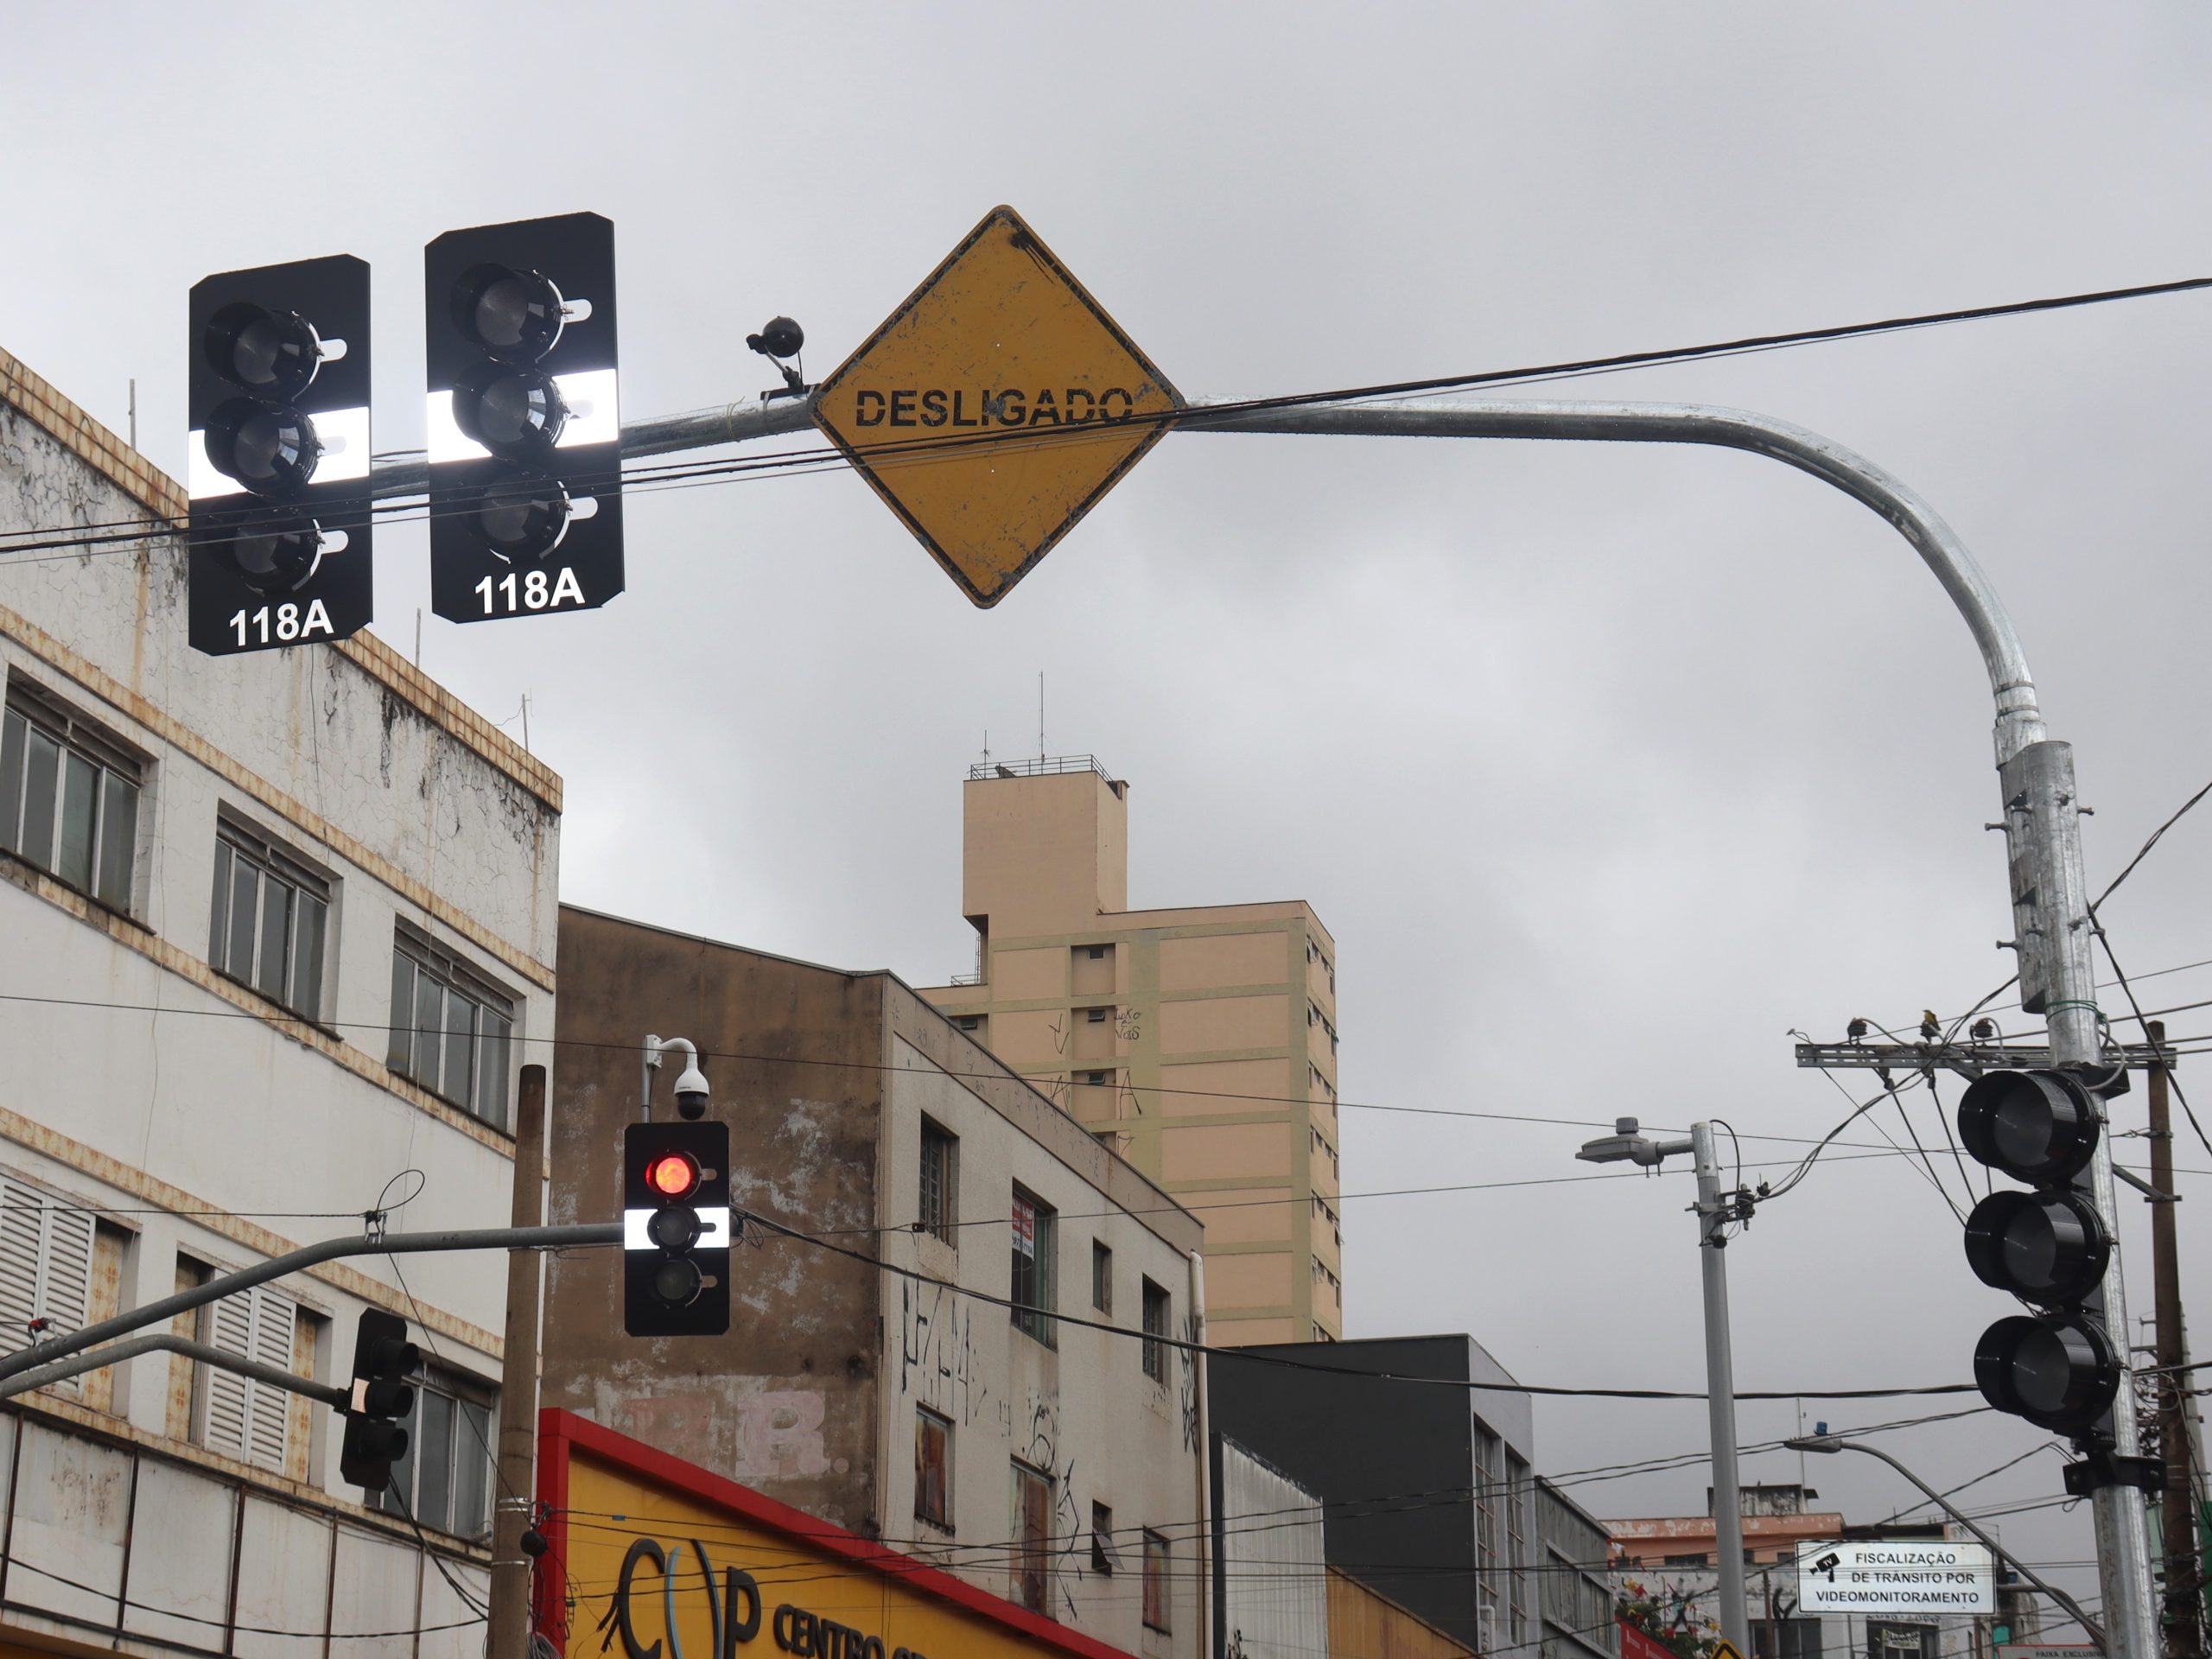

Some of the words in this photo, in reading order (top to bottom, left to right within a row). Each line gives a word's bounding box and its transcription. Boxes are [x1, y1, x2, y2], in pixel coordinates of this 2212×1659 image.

[855, 387, 1134, 427] DESLIGADO
[474, 567, 586, 614] 118A
[229, 599, 335, 646] 118A
[1852, 1572, 1870, 1583] DE
[1875, 1570, 1942, 1583] TRÂNSITO
[1947, 1573, 1976, 1584] POR
[1855, 1552, 1956, 1567] FISCALIZAÇÃO
[1816, 1591, 1979, 1604] VIDEOMONITORAMENTO
[772, 1604, 886, 1659] CENTRO
